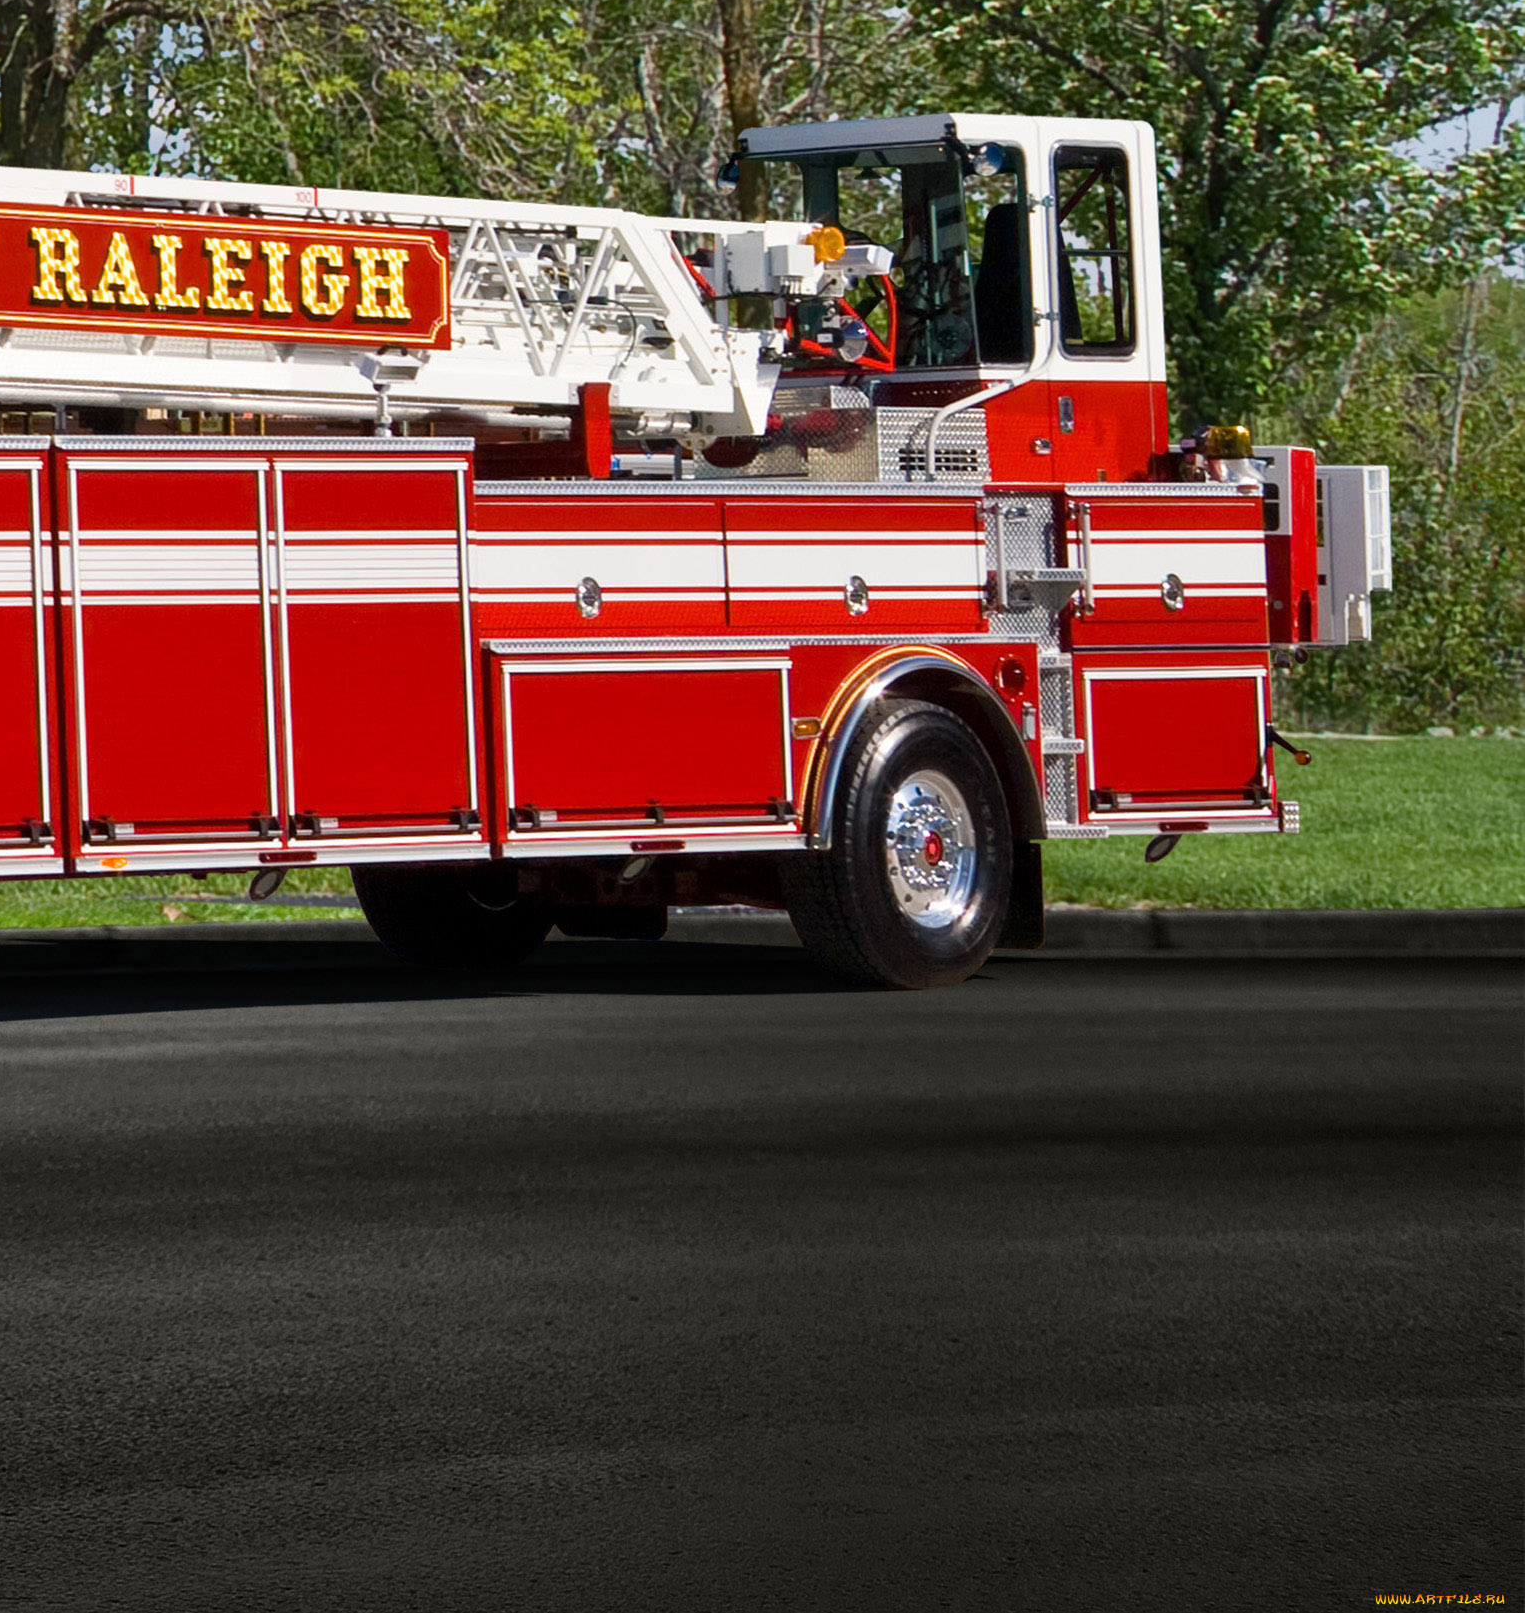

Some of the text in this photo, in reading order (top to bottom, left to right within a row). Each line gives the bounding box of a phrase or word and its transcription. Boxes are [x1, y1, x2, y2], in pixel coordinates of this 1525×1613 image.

[114, 179, 127, 191] 90
[295, 191, 311, 203] 100
[30, 227, 411, 320] RALEIGH
